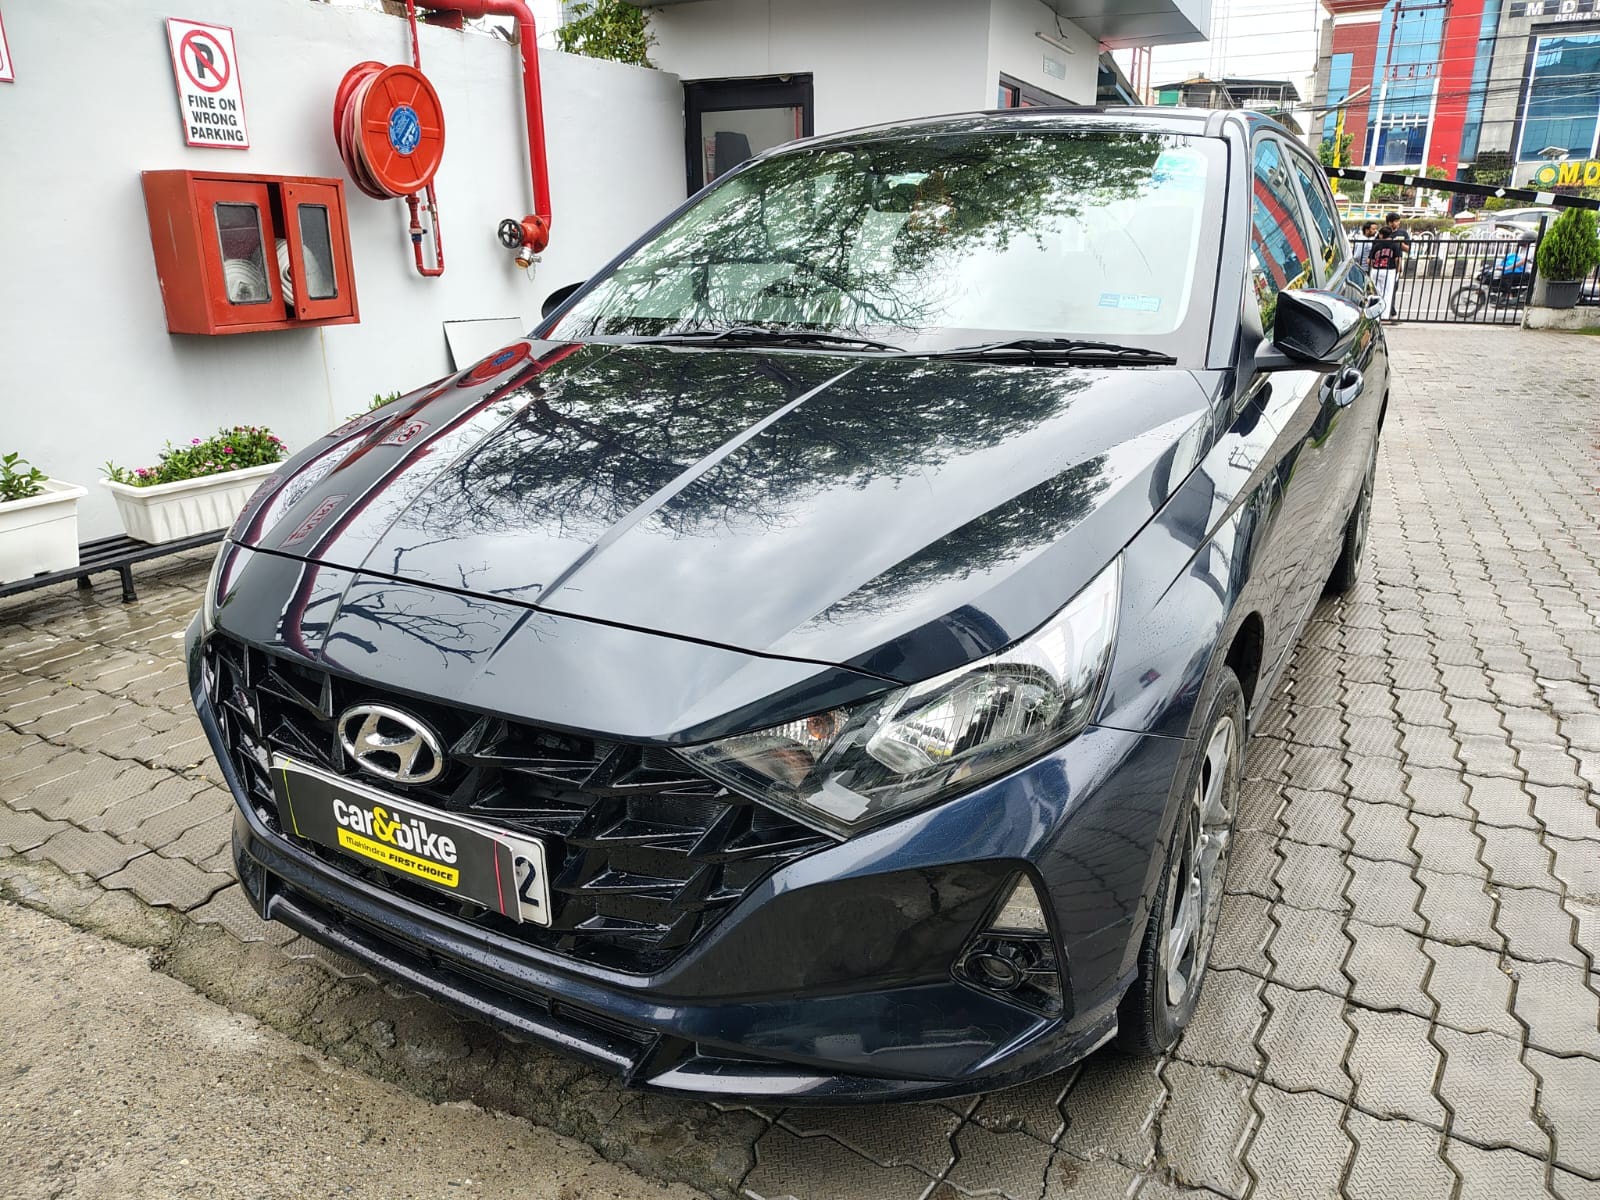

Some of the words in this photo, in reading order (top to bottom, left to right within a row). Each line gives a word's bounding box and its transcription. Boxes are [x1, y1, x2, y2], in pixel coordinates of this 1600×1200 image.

[187, 94, 216, 109] FINE
[219, 98, 236, 111] ON
[192, 111, 237, 126] WRONG
[190, 127, 243, 141] PARKING
[388, 853, 416, 868] FIRST
[417, 863, 453, 881] CHOICE
[515, 856, 539, 907] 2
